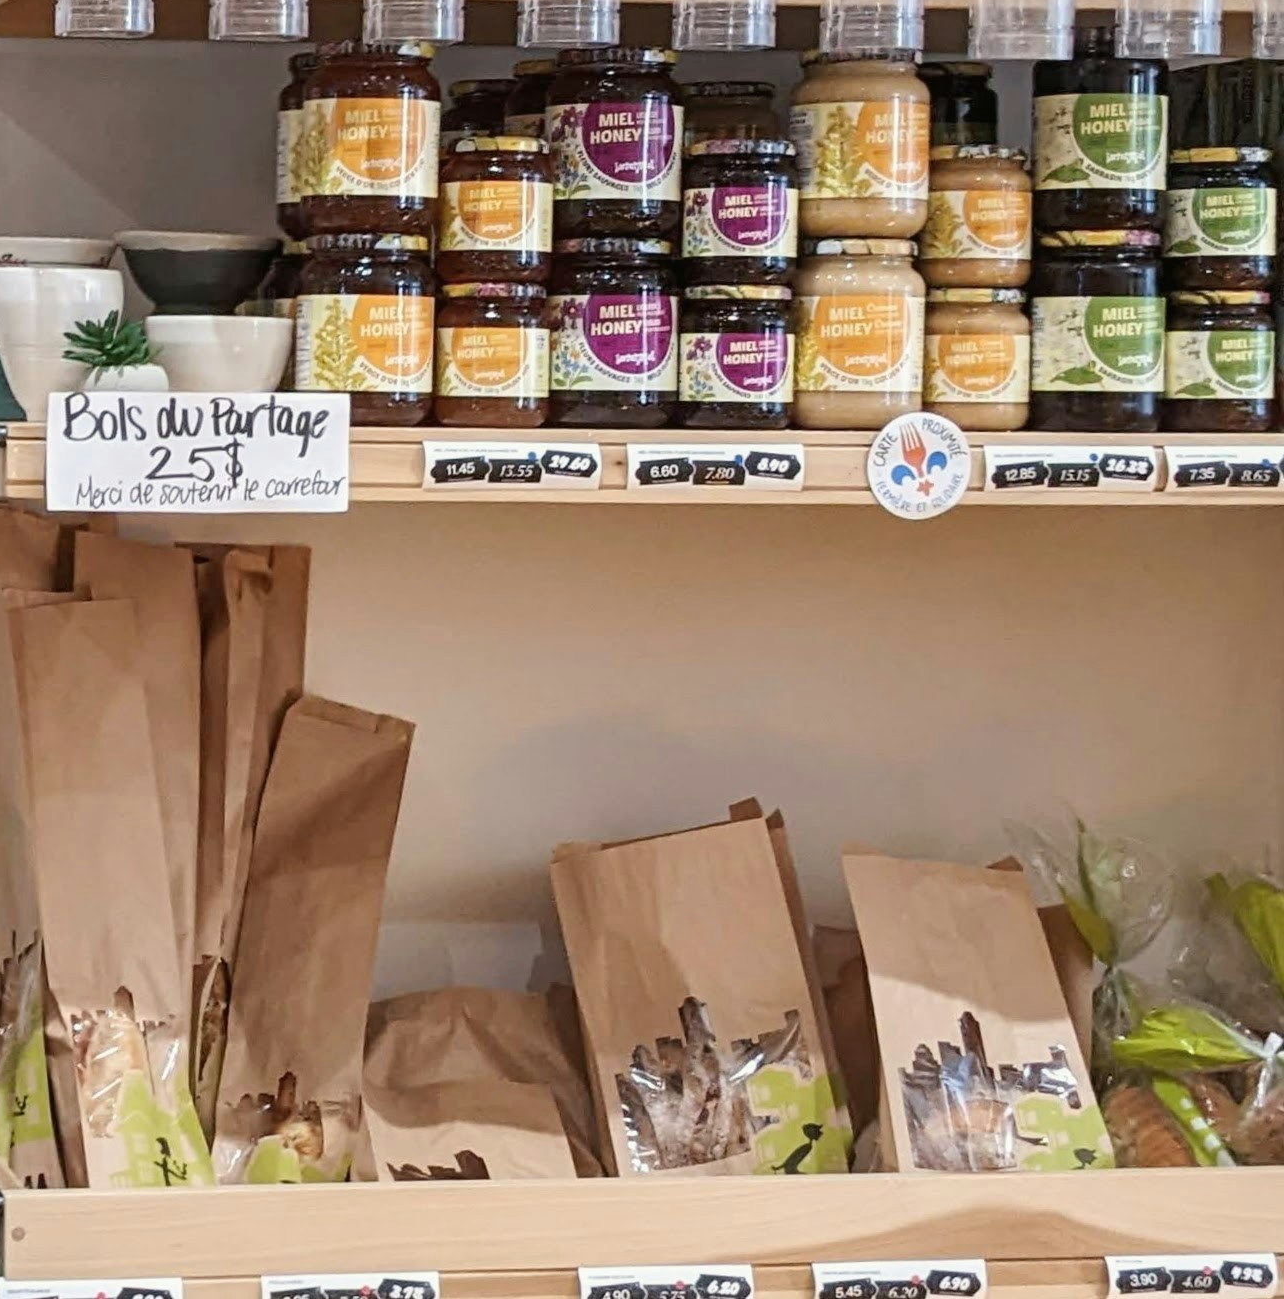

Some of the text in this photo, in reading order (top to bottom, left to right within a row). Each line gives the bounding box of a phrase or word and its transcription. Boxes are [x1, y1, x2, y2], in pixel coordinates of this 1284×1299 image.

[345, 109, 380, 124] MIEL
[1090, 103, 1126, 118] MIEL
[598, 111, 635, 127] MIEL
[337, 124, 388, 140] HONEY
[1080, 119, 1132, 135] HONEY
[590, 127, 643, 145] HONEY
[724, 194, 754, 207] MIEL
[1206, 194, 1235, 206] MIEL
[718, 206, 759, 220] HONEY
[1200, 207, 1242, 220] HONEY
[369, 306, 404, 321] MIEL
[599, 304, 636, 319] MIEL
[828, 306, 865, 322] MIEL
[1102, 308, 1137, 322] MIEL
[360, 322, 410, 338] HONEY
[590, 319, 642, 336] HONEY
[820, 321, 873, 338] HONEY
[1093, 322, 1143, 338] HONEY
[729, 340, 758, 353] MIEL
[1222, 339, 1250, 351] MIEL
[723, 352, 763, 366] HONEY
[1215, 350, 1254, 363] HONEY
[156, 397, 204, 439] du
[209, 395, 331, 458] Partage
[873, 432, 899, 467] CARTE
[499, 464, 534, 478] 13.55
[650, 464, 735, 480] 6.60 7.80
[1005, 467, 1037, 481] 12.85
[76, 476, 260, 509] Merci de soutenir le
[1129, 1273, 1158, 1287] 3.90
[835, 1285, 862, 1299] 5.45
